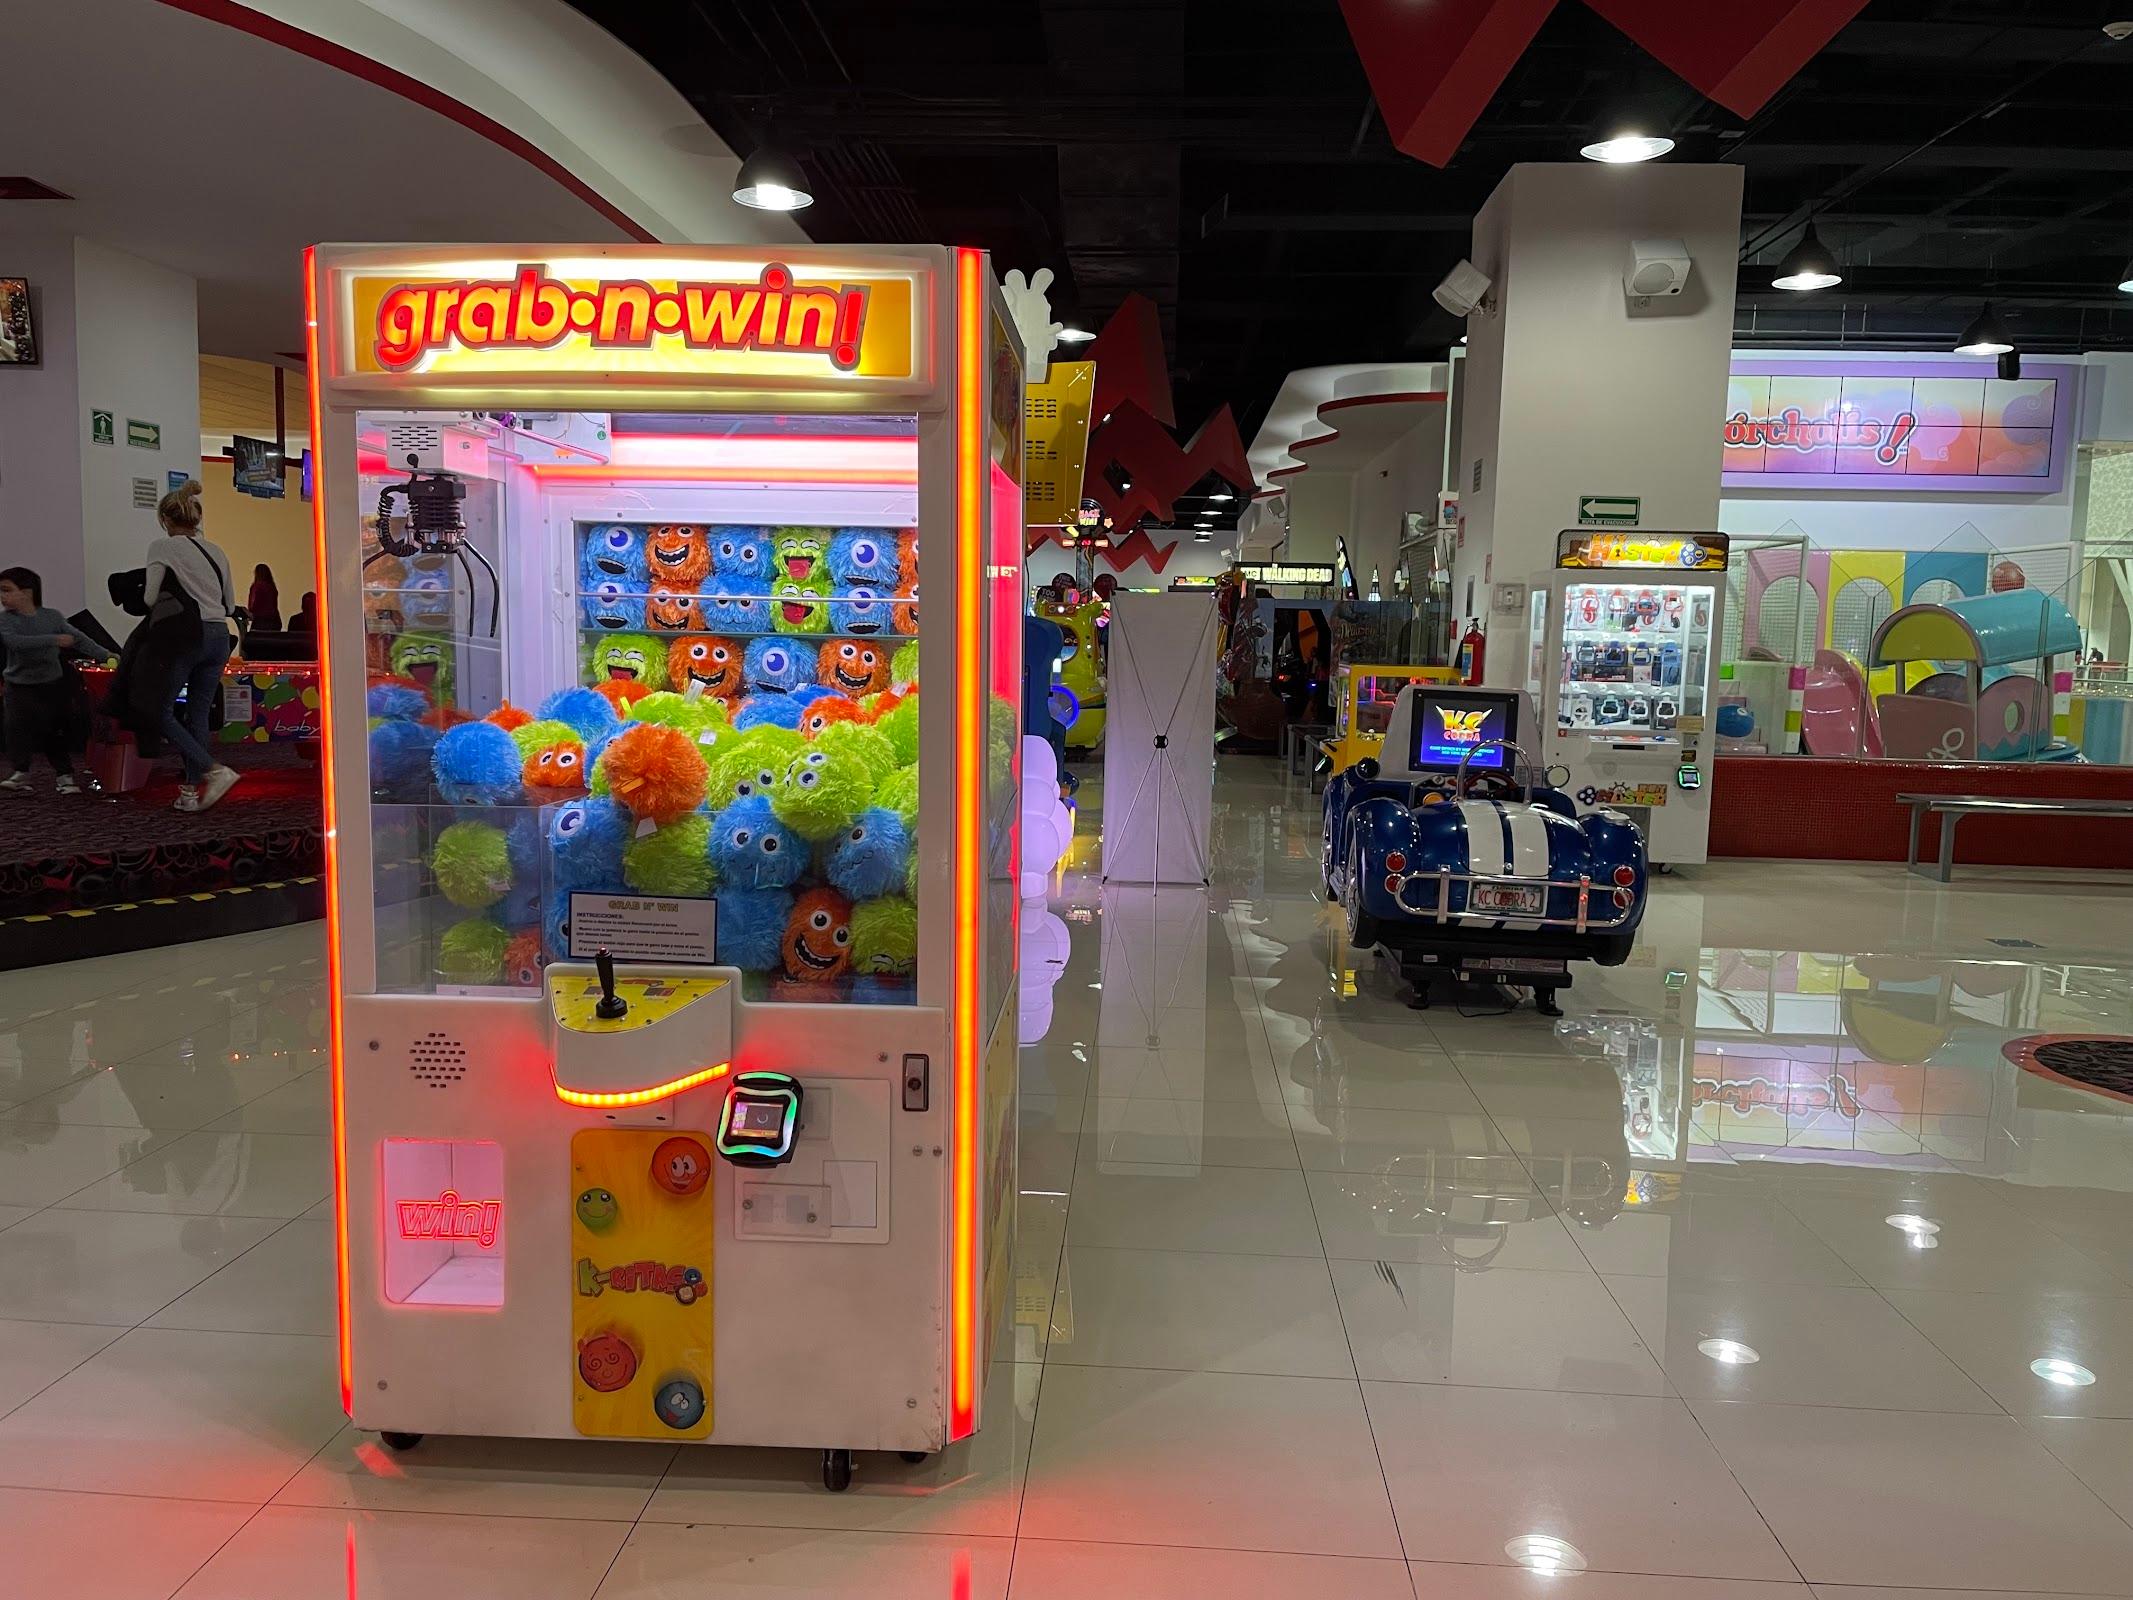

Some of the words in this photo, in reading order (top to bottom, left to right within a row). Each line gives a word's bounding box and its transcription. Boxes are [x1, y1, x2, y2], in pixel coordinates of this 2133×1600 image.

[1262, 567, 1306, 581] WALKING
[1306, 568, 1333, 582] DEAD
[608, 900, 640, 911] GRAB
[657, 902, 679, 912] WIN
[1478, 889, 1492, 905] KC
[1529, 893, 1536, 908] 2
[396, 1190, 502, 1249] win!
